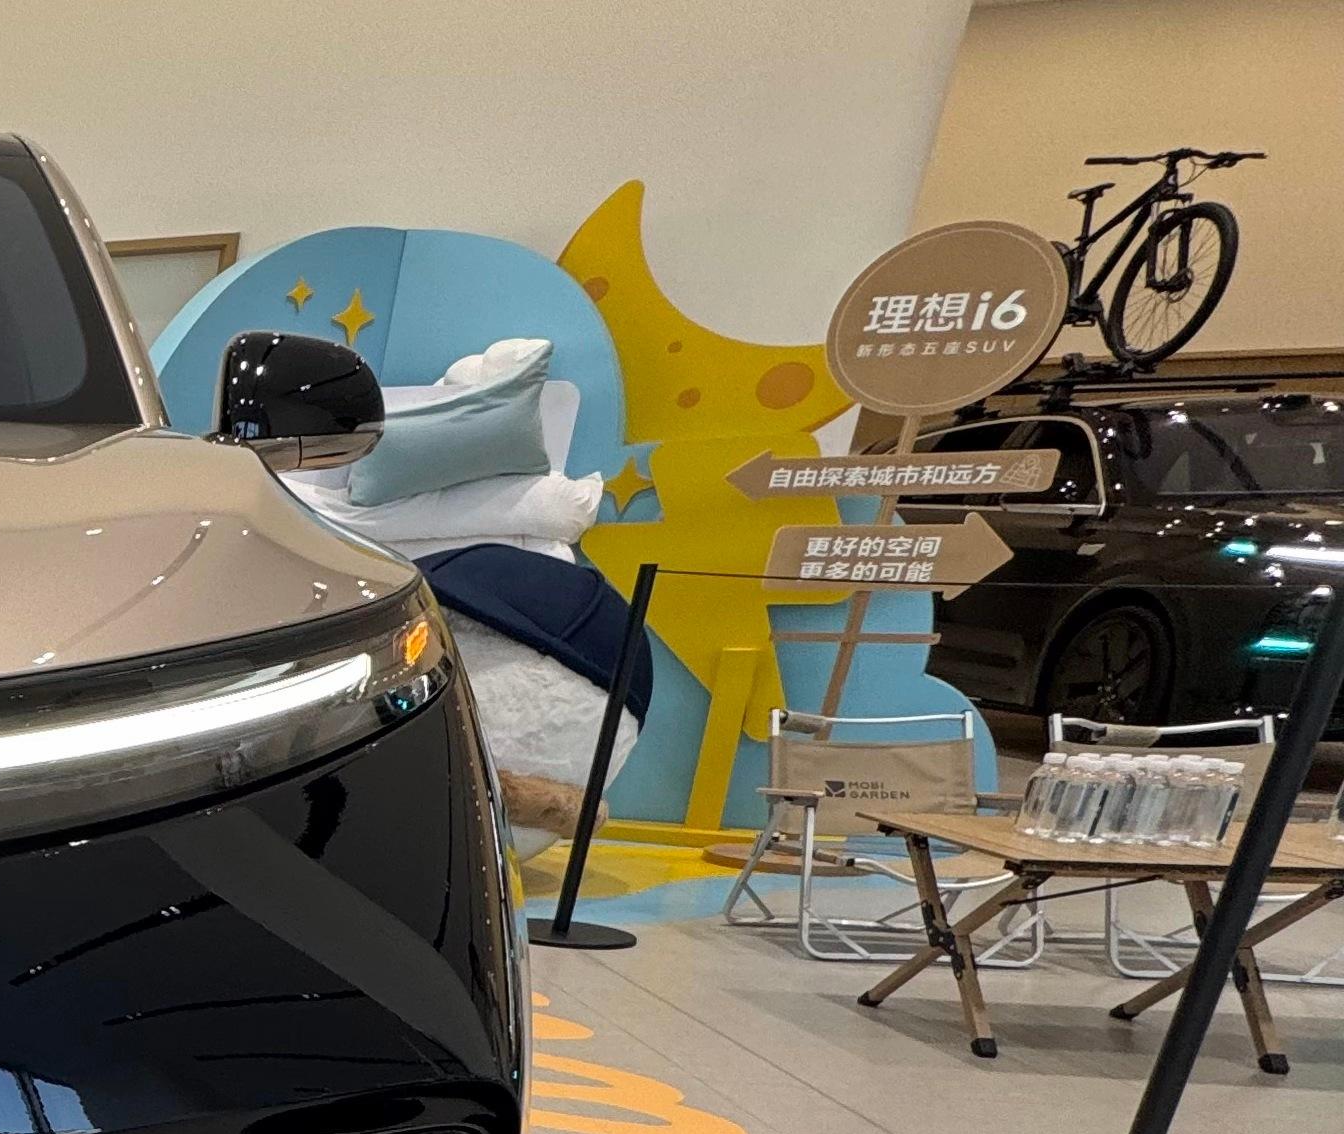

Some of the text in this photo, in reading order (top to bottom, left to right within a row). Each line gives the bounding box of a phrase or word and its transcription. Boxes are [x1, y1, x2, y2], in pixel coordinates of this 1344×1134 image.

[863, 289, 1028, 334] 理想i6
[768, 463, 1002, 489] 自由探索城市和远方
[804, 536, 943, 558] 更好的空间
[799, 561, 934, 583] 更多的可能
[848, 781, 884, 790] MOBI
[849, 790, 911, 799] GARDEN
